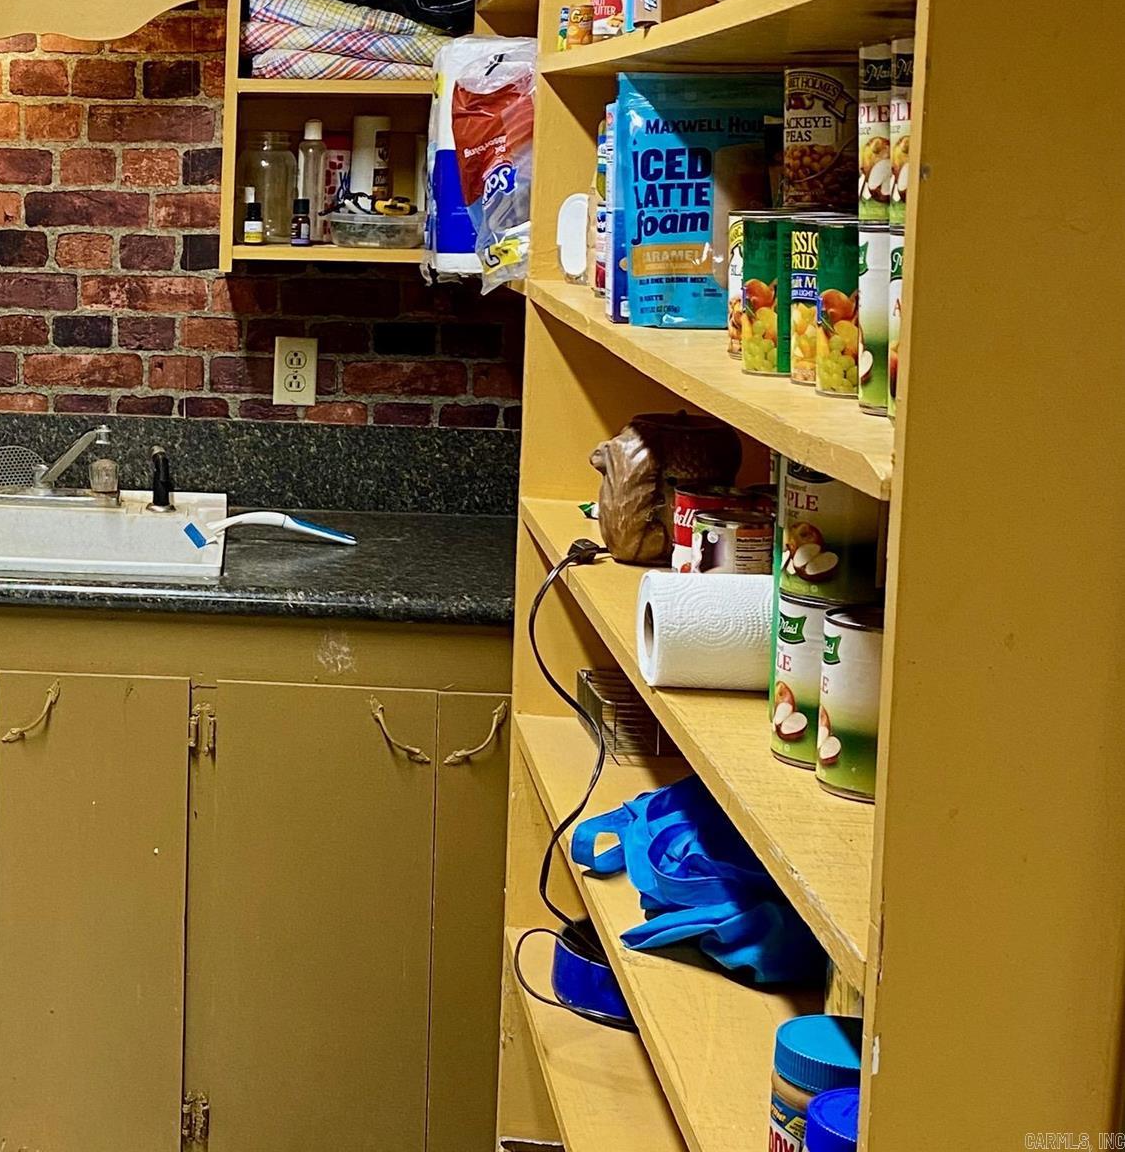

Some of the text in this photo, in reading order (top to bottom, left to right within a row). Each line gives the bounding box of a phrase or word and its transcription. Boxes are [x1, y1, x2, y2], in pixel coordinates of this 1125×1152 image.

[645, 116, 725, 135] MAXWELL
[633, 148, 713, 182] ICED
[634, 181, 711, 209] LATTE
[631, 210, 710, 245] foam
